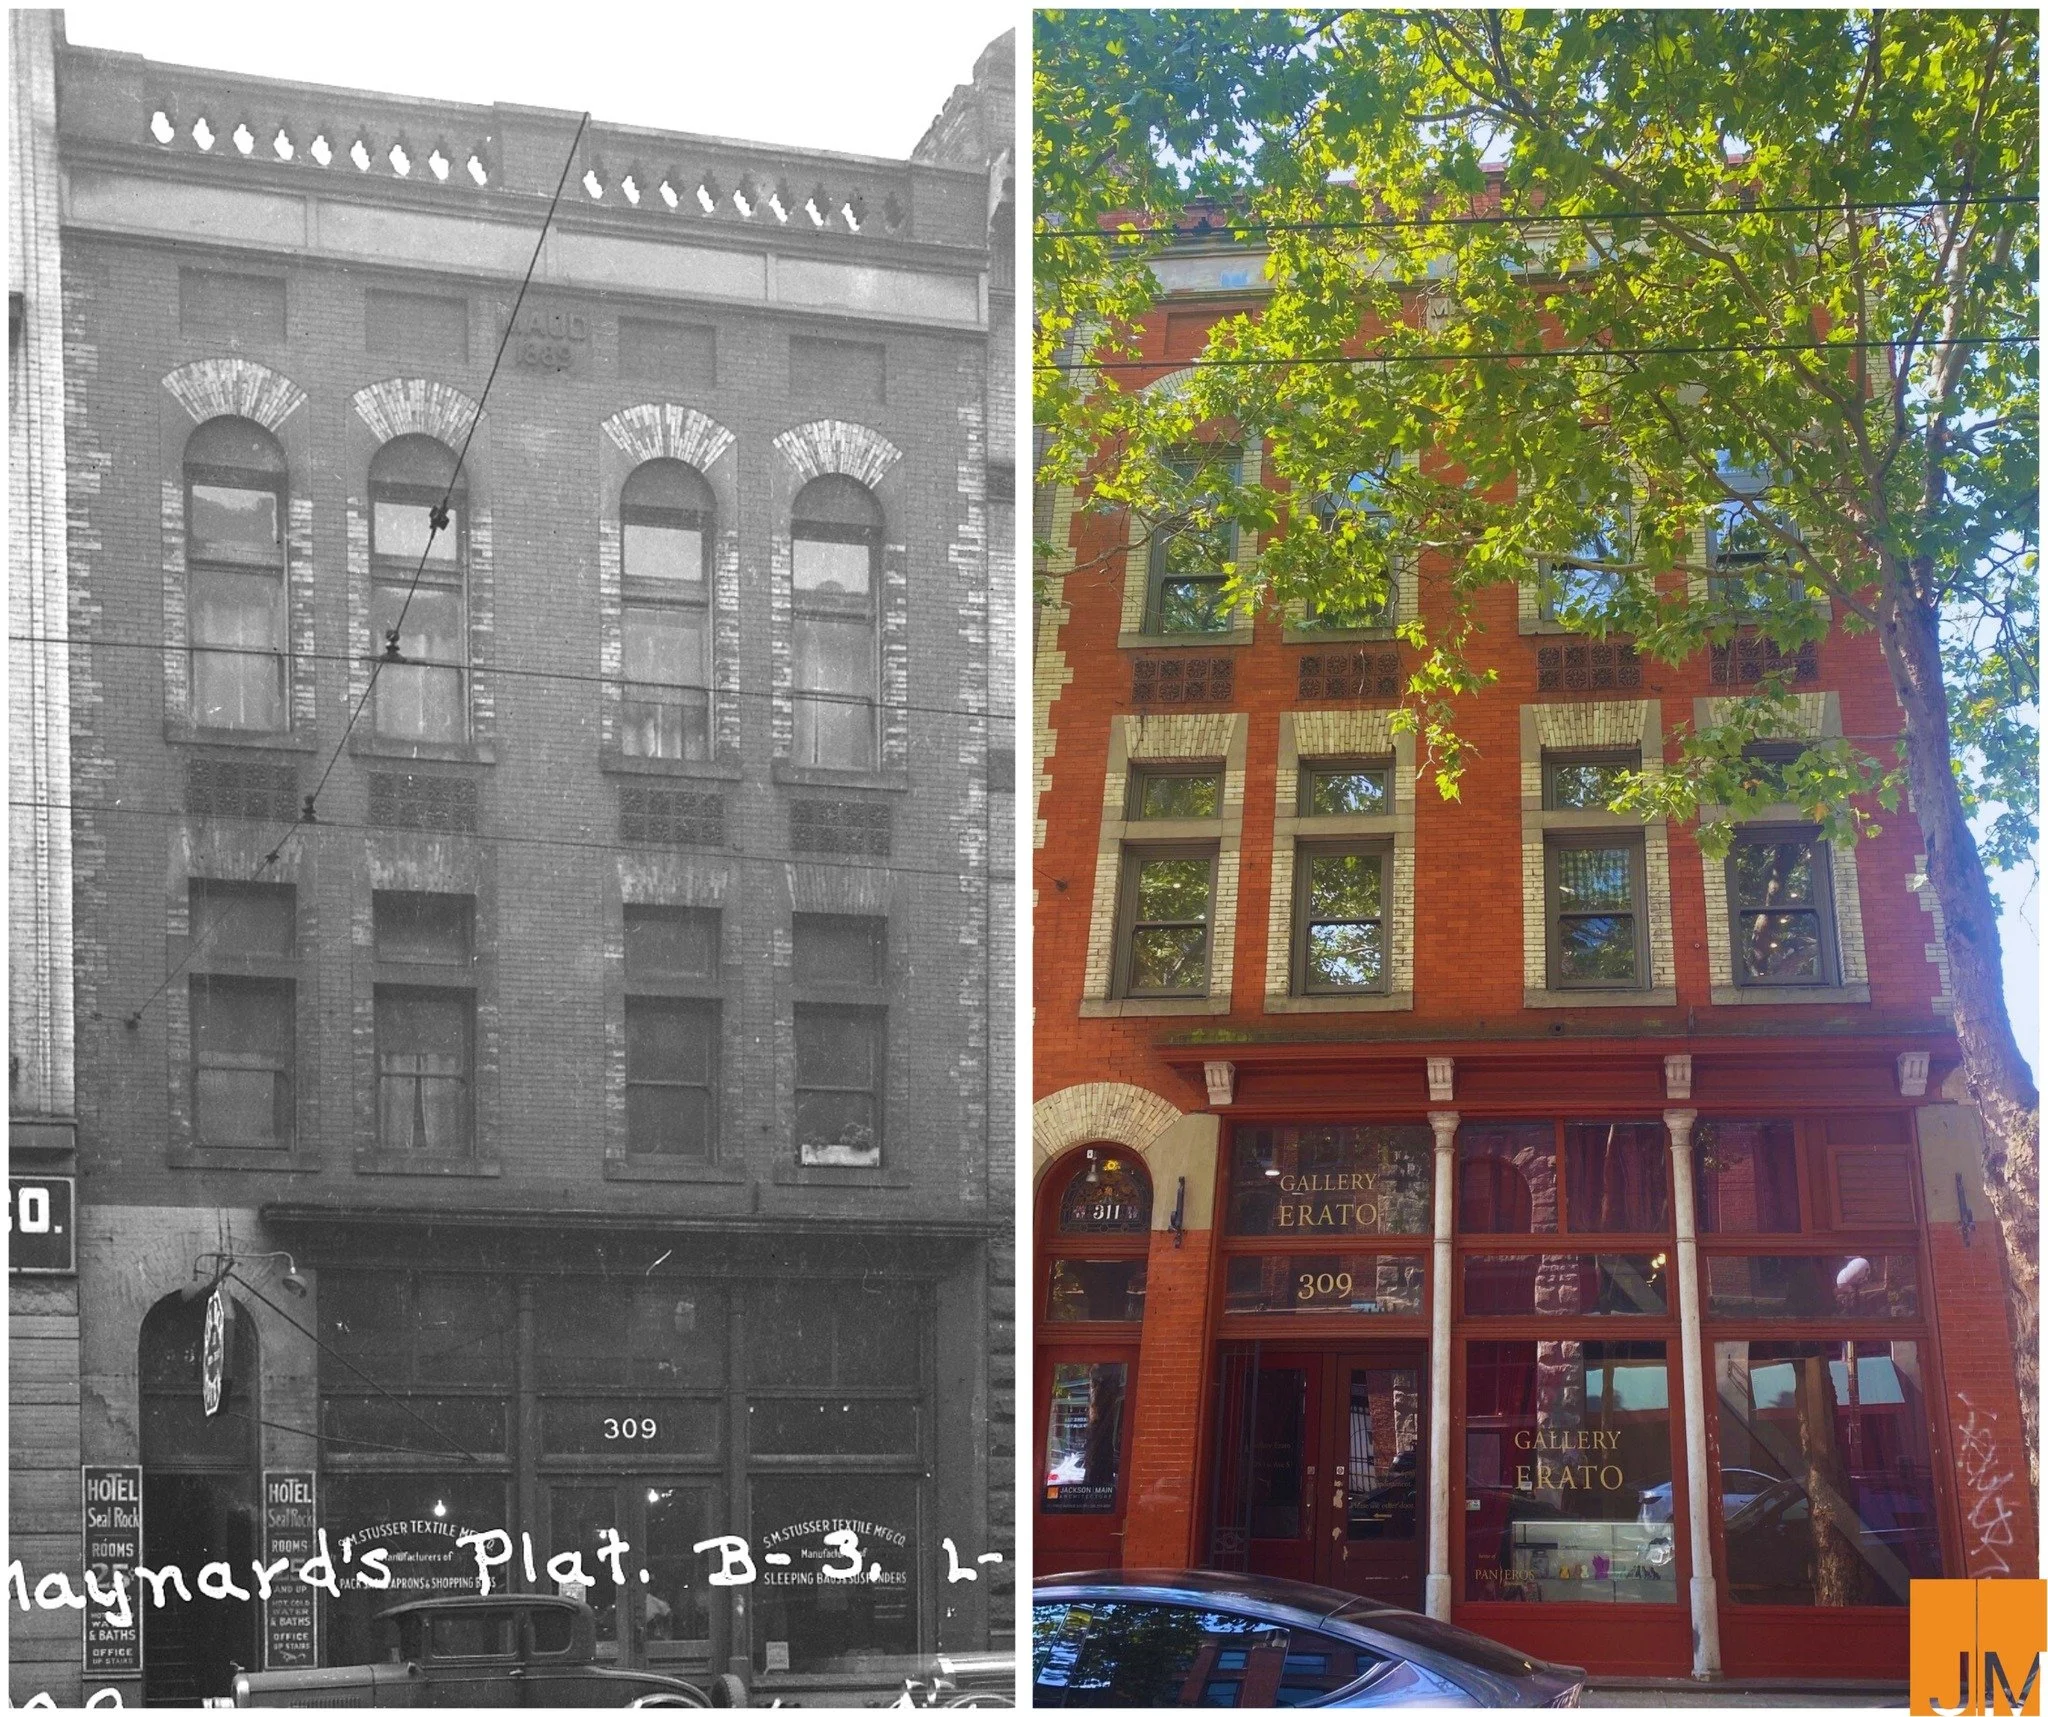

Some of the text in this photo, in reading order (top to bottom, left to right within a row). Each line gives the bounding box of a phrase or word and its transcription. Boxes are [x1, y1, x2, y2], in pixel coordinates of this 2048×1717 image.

[1280, 1173, 1378, 1192] GALLERY
[1093, 1204, 1120, 1220] 311
[1279, 1203, 1378, 1227] ERATO
[1298, 1272, 1352, 1300] 309
[603, 1417, 657, 1440] 309
[1514, 1430, 1620, 1450] GALLERY
[1515, 1465, 1624, 1490] ERATO
[87, 1472, 139, 1502] HOTEL
[268, 1478, 312, 1503] HOTEL
[1060, 1486, 1113, 1494] JACKSON MAIN
[88, 1506, 140, 1528] Seal Rock
[410, 1520, 457, 1538] TEXTILE
[832, 1519, 872, 1534] TEXTILE
[91, 1542, 134, 1558] ROOMS
[271, 1540, 308, 1553] ROOMS
[385, 1550, 454, 1561] anufacturers of
[764, 1572, 814, 1585] SLEEPING
[295, 1585, 307, 1593] UP
[279, 1617, 311, 1627] BATHS
[98, 1629, 136, 1641] BATHS
[273, 1633, 309, 1641] OFFICE
[92, 1648, 133, 1657] OFFICE
